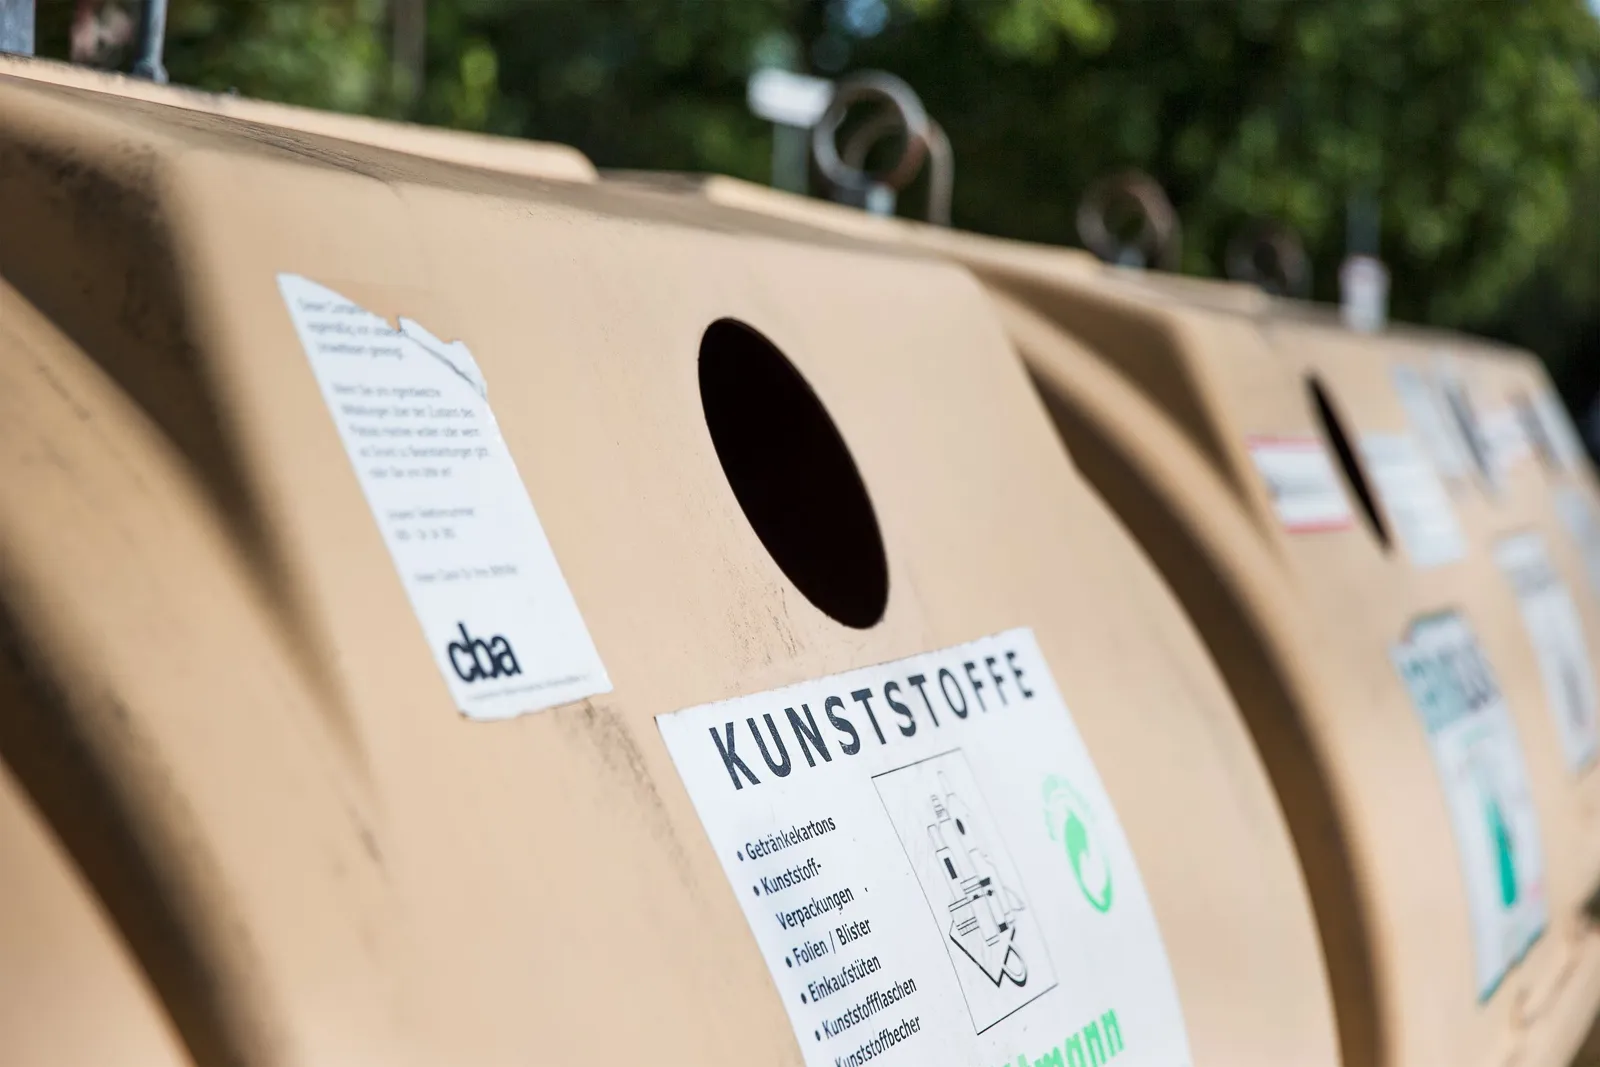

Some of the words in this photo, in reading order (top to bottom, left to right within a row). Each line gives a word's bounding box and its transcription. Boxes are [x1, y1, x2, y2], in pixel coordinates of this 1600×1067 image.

[708, 650, 1034, 790] KUNSTSTOFFE
[745, 816, 837, 860] Getränkekartons
[759, 857, 822, 896] Kunststoff-
[775, 885, 855, 931] Verpackungen
[792, 938, 829, 967] Folien
[828, 930, 837, 955] /
[835, 918, 872, 947] Blister
[807, 954, 882, 1003] Einkaufstüten
[834, 1015, 922, 1067] Kunststoffbecher
